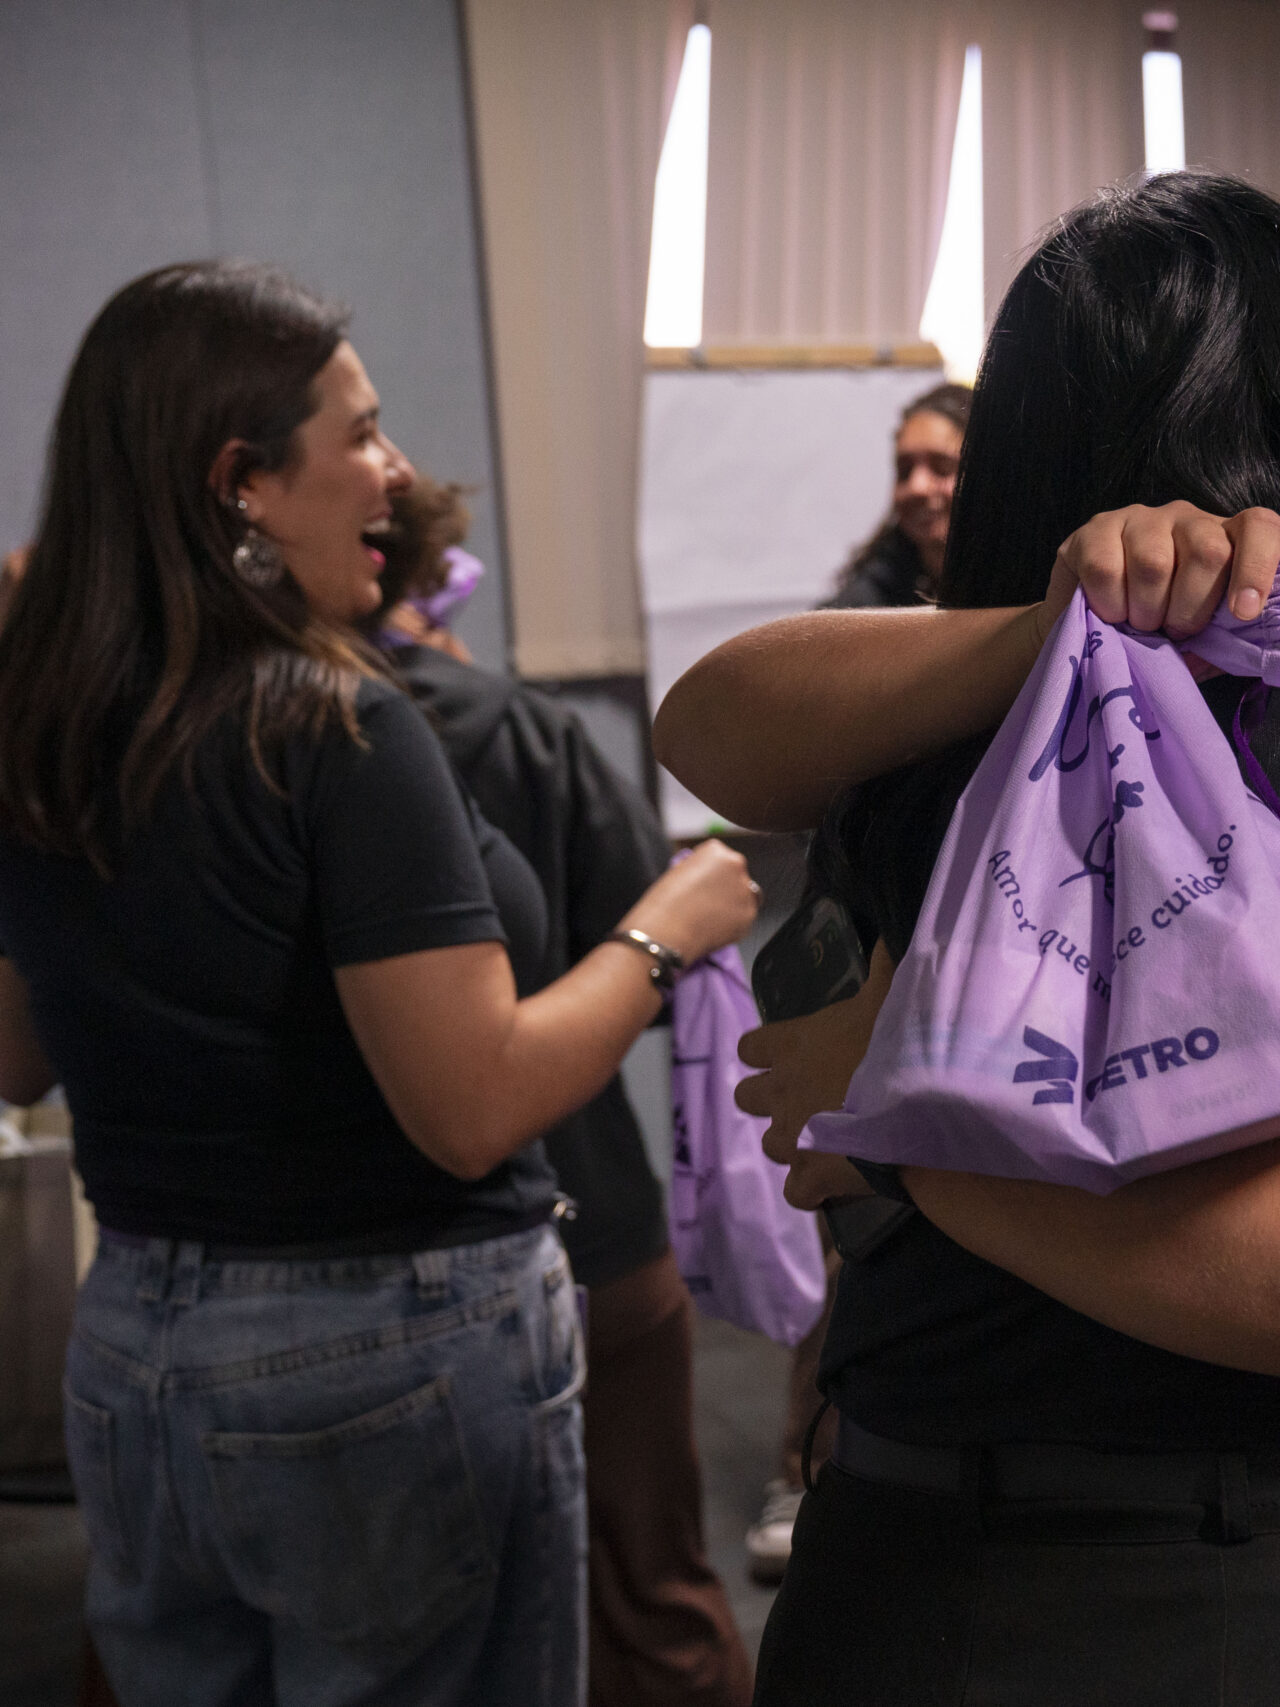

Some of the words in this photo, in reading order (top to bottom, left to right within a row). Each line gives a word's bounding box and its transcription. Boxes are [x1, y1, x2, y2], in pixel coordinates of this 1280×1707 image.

[988, 850, 1037, 932] Amor
[1039, 930, 1090, 975] que
[1151, 824, 1236, 929] cuidado.
[1085, 1026, 1220, 1102] ETRO
